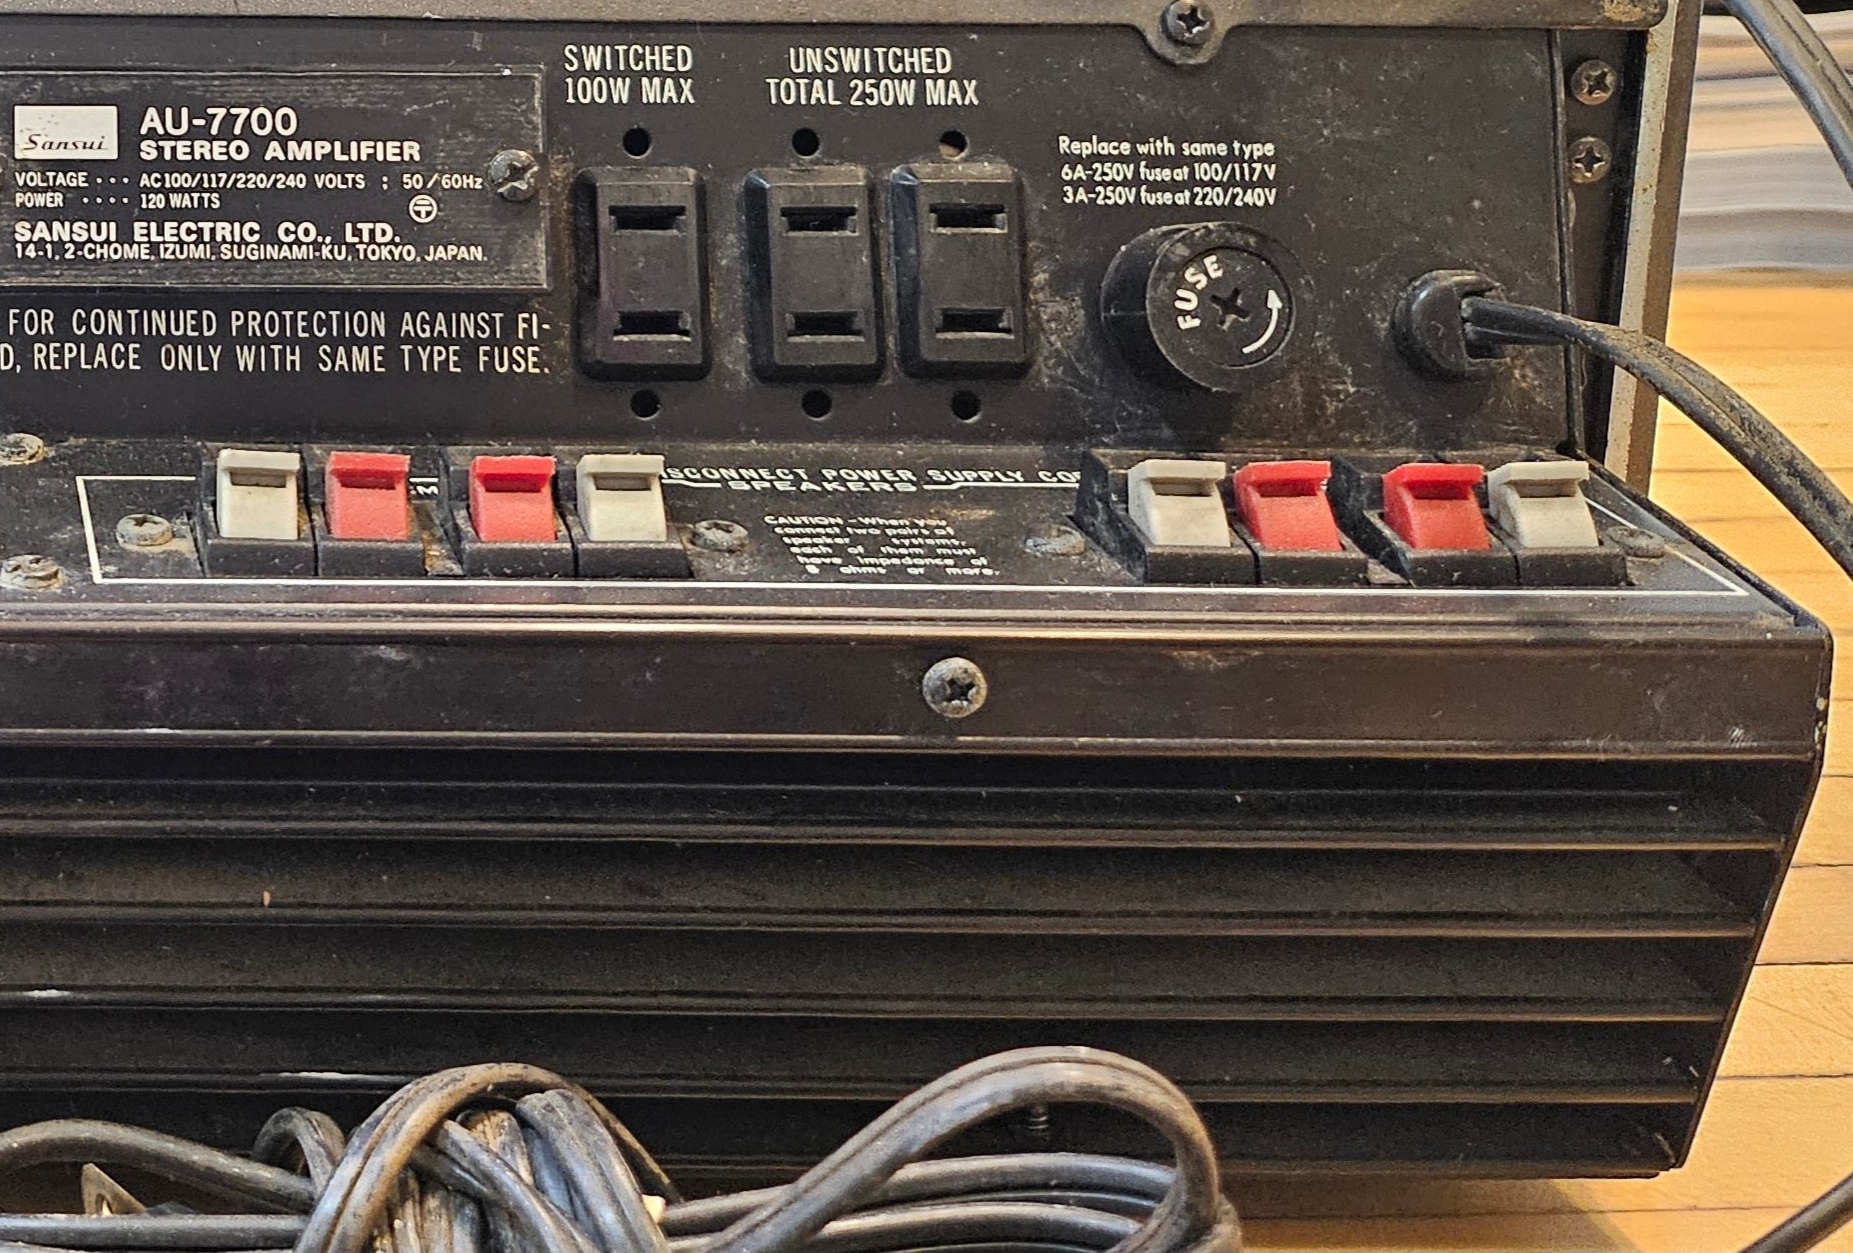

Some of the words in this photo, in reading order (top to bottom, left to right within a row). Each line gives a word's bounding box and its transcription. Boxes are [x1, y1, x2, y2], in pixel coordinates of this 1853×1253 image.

[564, 44, 693, 72] SWITCHED
[789, 46, 952, 74] UNSWITCHED
[565, 76, 631, 104] 100W
[641, 76, 696, 104] MAX
[765, 77, 843, 106] TOTAL
[849, 78, 916, 106] 250W
[925, 78, 979, 106] MAX
[140, 106, 298, 136] AU-7700
[23, 133, 109, 152] Sansui
[139, 139, 250, 161] STEREO
[264, 140, 421, 162] AMPLIFIER
[1058, 134, 1131, 159] Replace
[1135, 135, 1176, 156] with
[1181, 142, 1228, 157] same
[1232, 139, 1275, 161] type
[15, 191, 64, 208] POWER
[140, 192, 166, 209] 120
[168, 192, 221, 209] WATTS
[14, 220, 117, 243] SANSUI
[133, 221, 261, 243] ELECTRIC
[277, 221, 332, 245] CO.,
[345, 222, 401, 244] LTD.
[1174, 254, 1224, 330] FUSE
[9, 308, 54, 336] FOR
[72, 308, 217, 337] CONTINUED
[231, 310, 386, 338] PROTECTION
[400, 310, 504, 339] AGAINST
[518, 312, 551, 340] FI-
[33, 342, 142, 371] REPLACE
[160, 343, 222, 372] ONLY
[235, 344, 301, 373] WITH
[318, 344, 386, 373] SAME
[399, 344, 462, 373] TYPE
[479, 345, 550, 374] FUSE.
[727, 480, 918, 492] SPEAKERS
